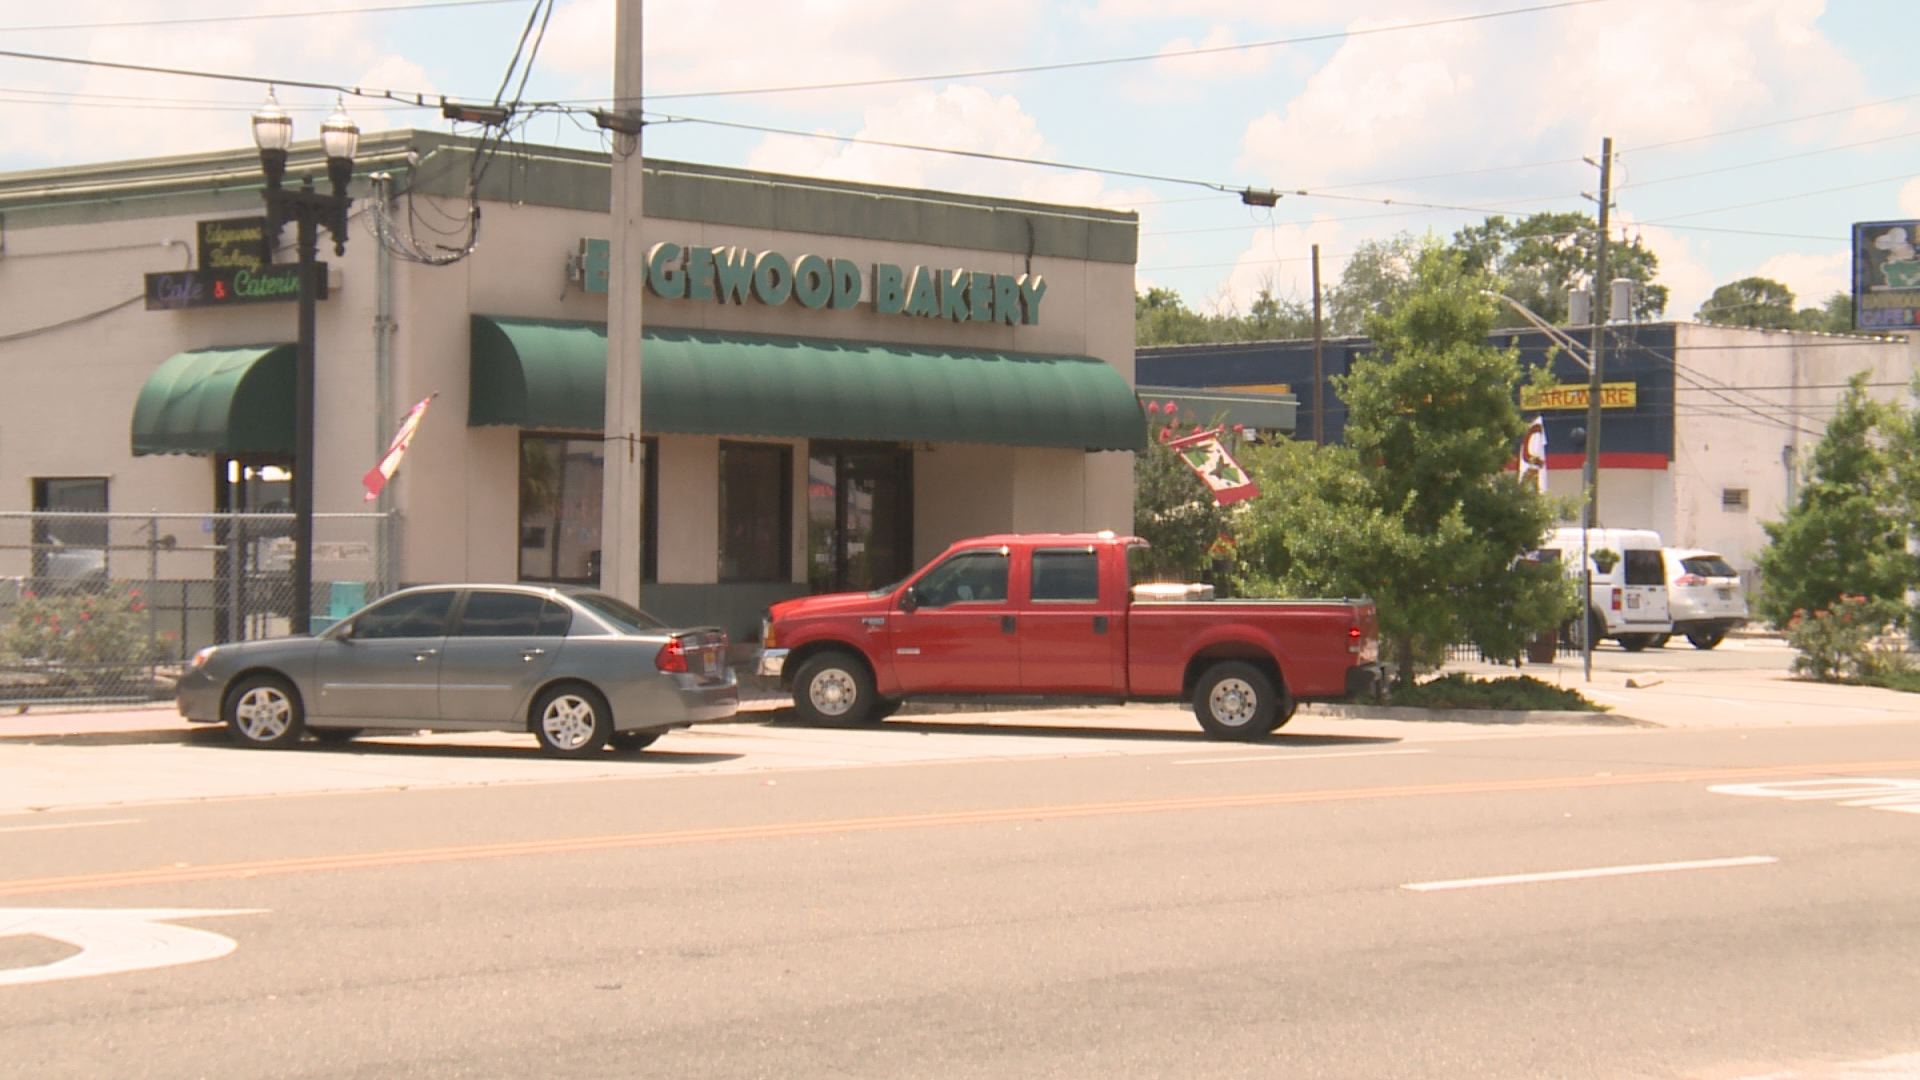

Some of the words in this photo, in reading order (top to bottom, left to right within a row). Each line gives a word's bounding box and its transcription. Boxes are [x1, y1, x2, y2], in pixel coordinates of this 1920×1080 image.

[214, 280, 226, 299] &
[233, 269, 300, 298] Caterin
[580, 237, 862, 309] EGEWOOD
[872, 262, 1047, 326] BAKERY
